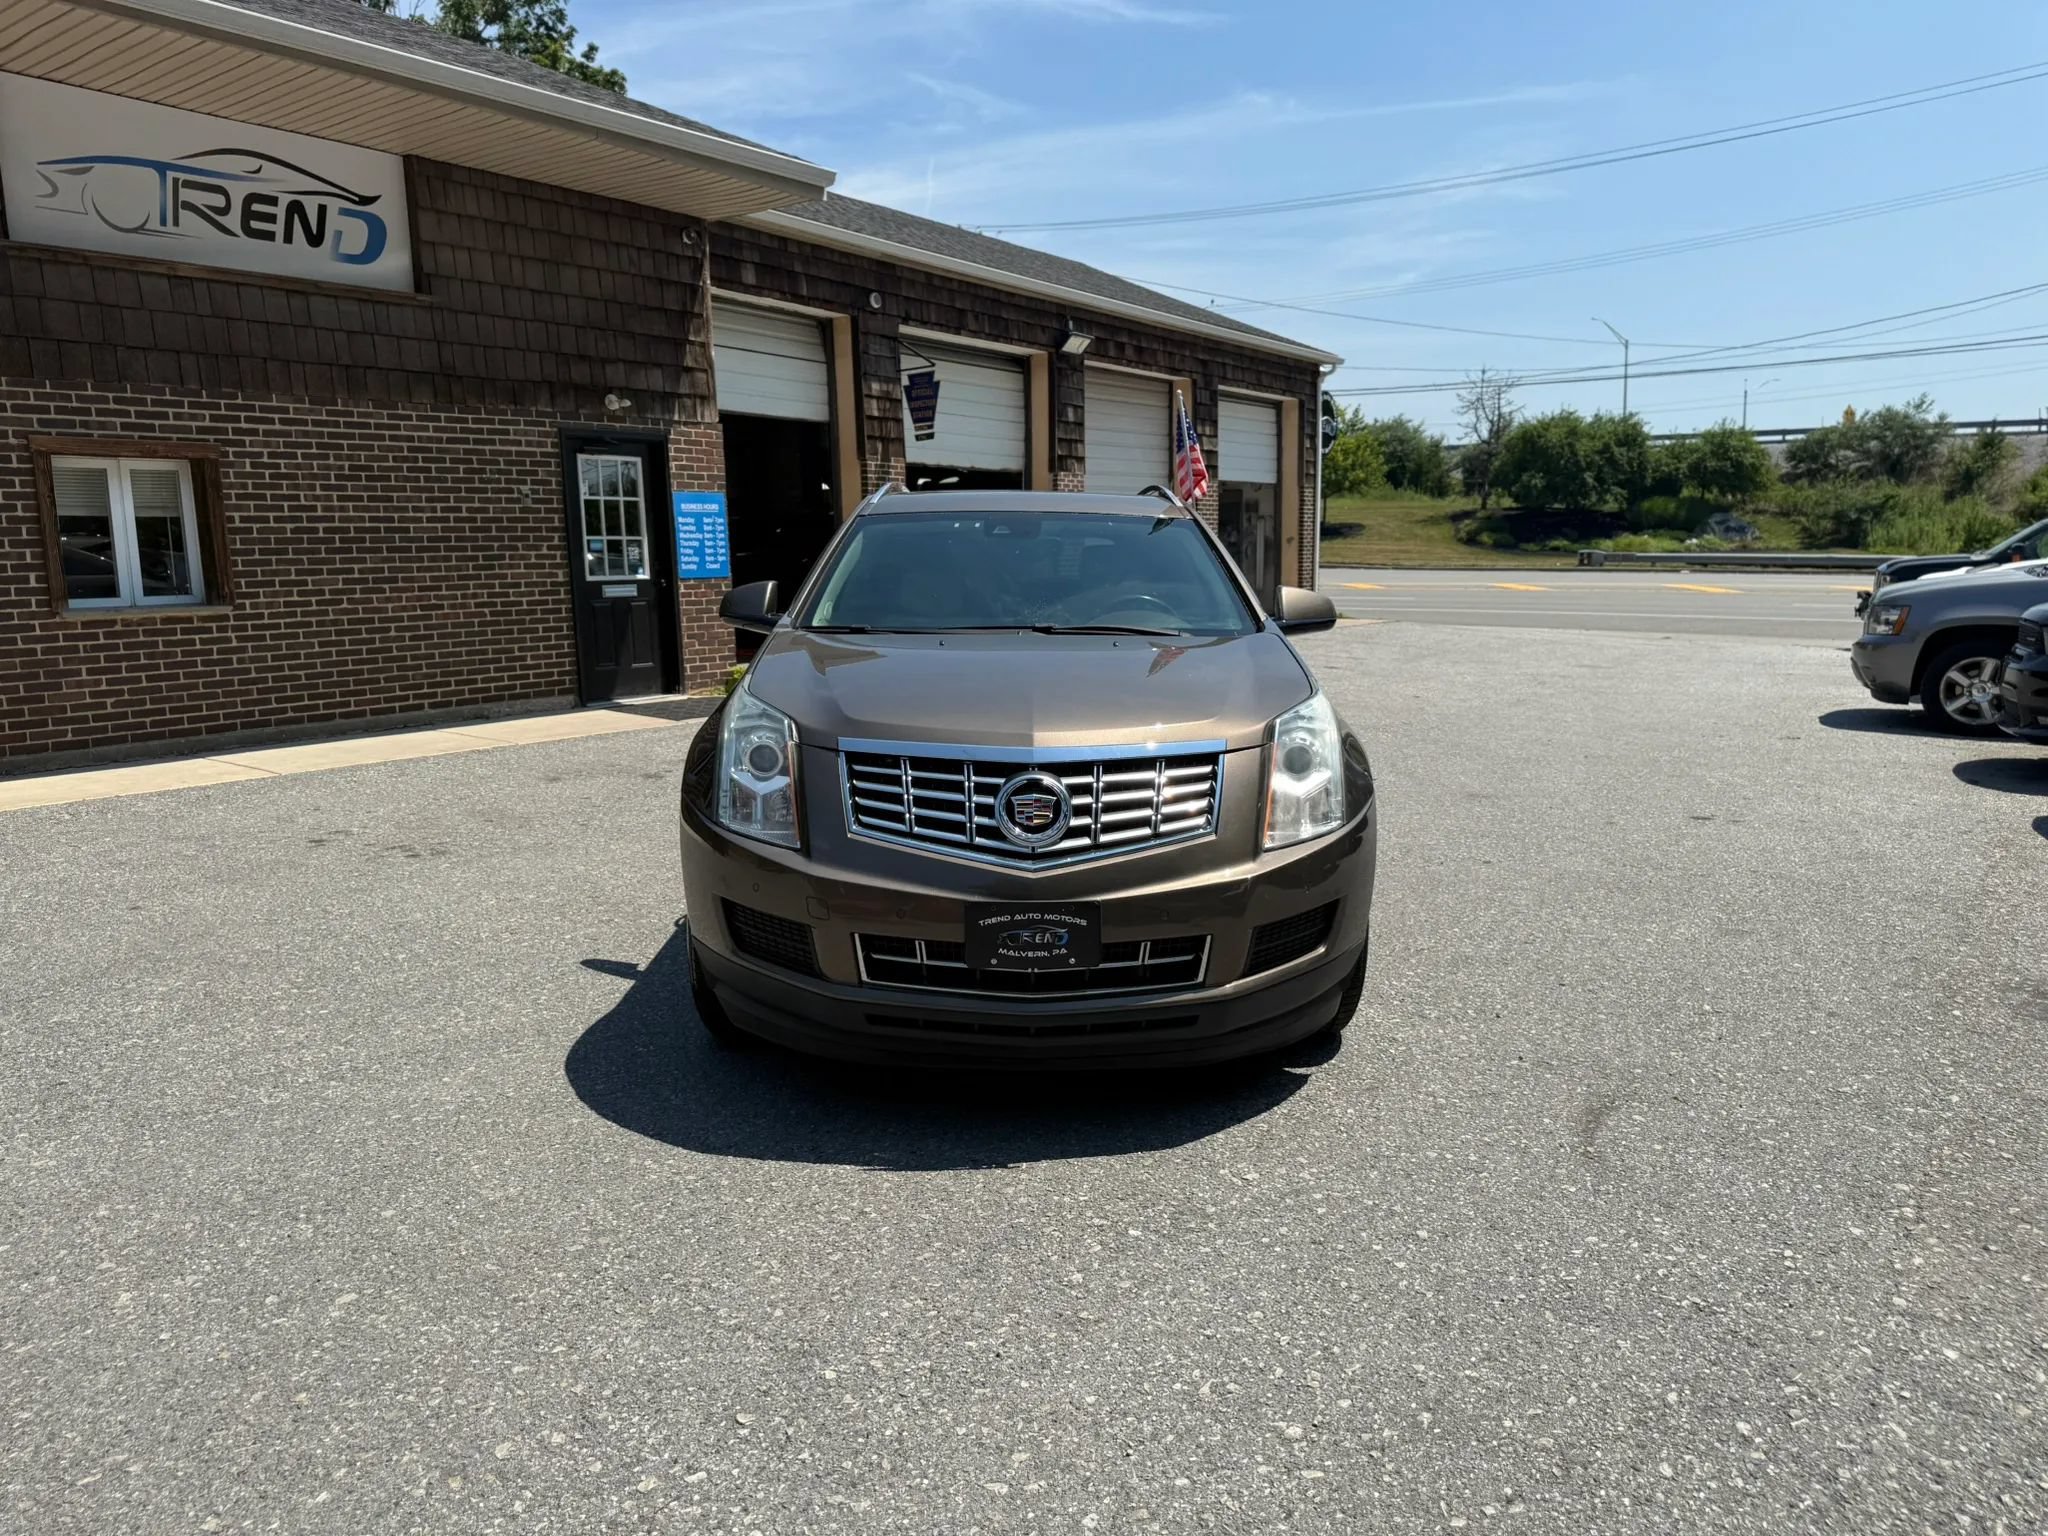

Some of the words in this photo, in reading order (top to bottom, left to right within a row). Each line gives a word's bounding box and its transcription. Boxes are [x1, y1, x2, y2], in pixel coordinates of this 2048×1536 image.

[154, 160, 388, 266] TREND
[978, 914, 1011, 927] TREND
[1043, 913, 1088, 926] MOTORS
[1052, 947, 1068, 955] PA
